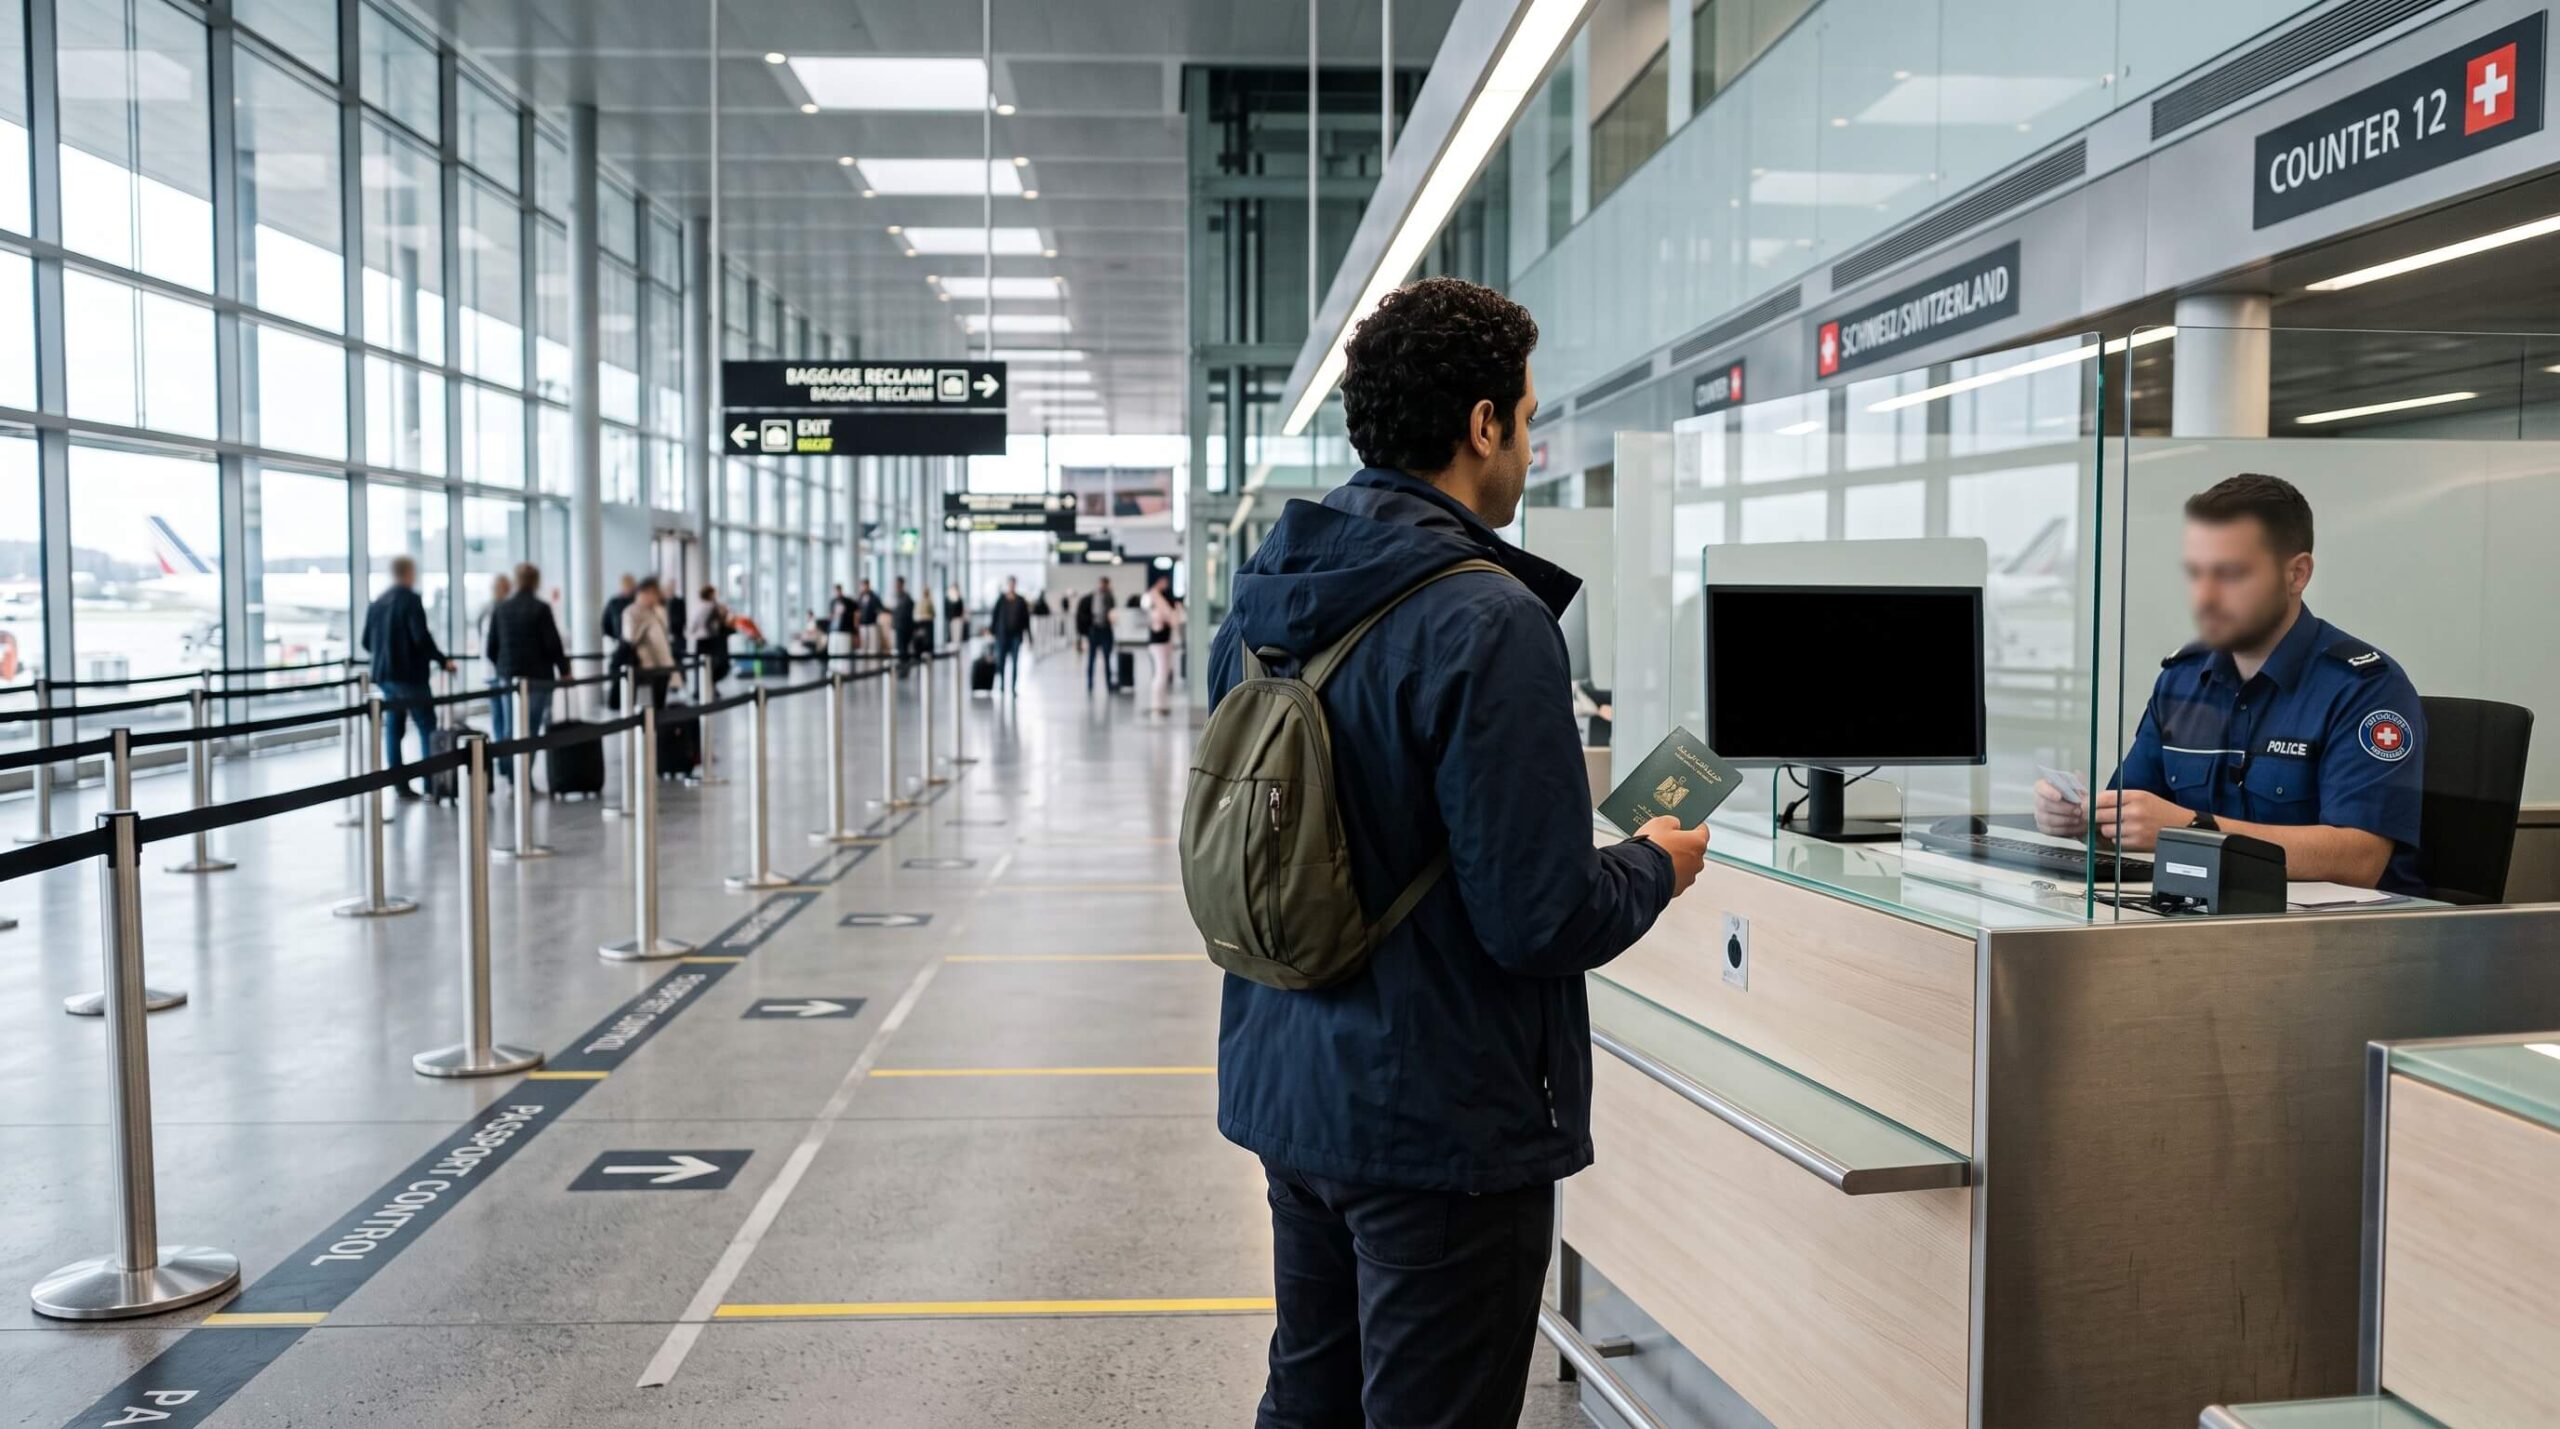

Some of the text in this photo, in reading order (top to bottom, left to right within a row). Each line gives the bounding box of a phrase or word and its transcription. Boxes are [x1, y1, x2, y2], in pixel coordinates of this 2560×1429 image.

[2269, 88, 2447, 194] COUNTER 12
[786, 367, 935, 386] BAGGAGE RECLAIM
[797, 418, 832, 436] EXIT
[2266, 740, 2308, 756] POLICE
[310, 1105, 544, 1266] PASSPORT CONTROL
